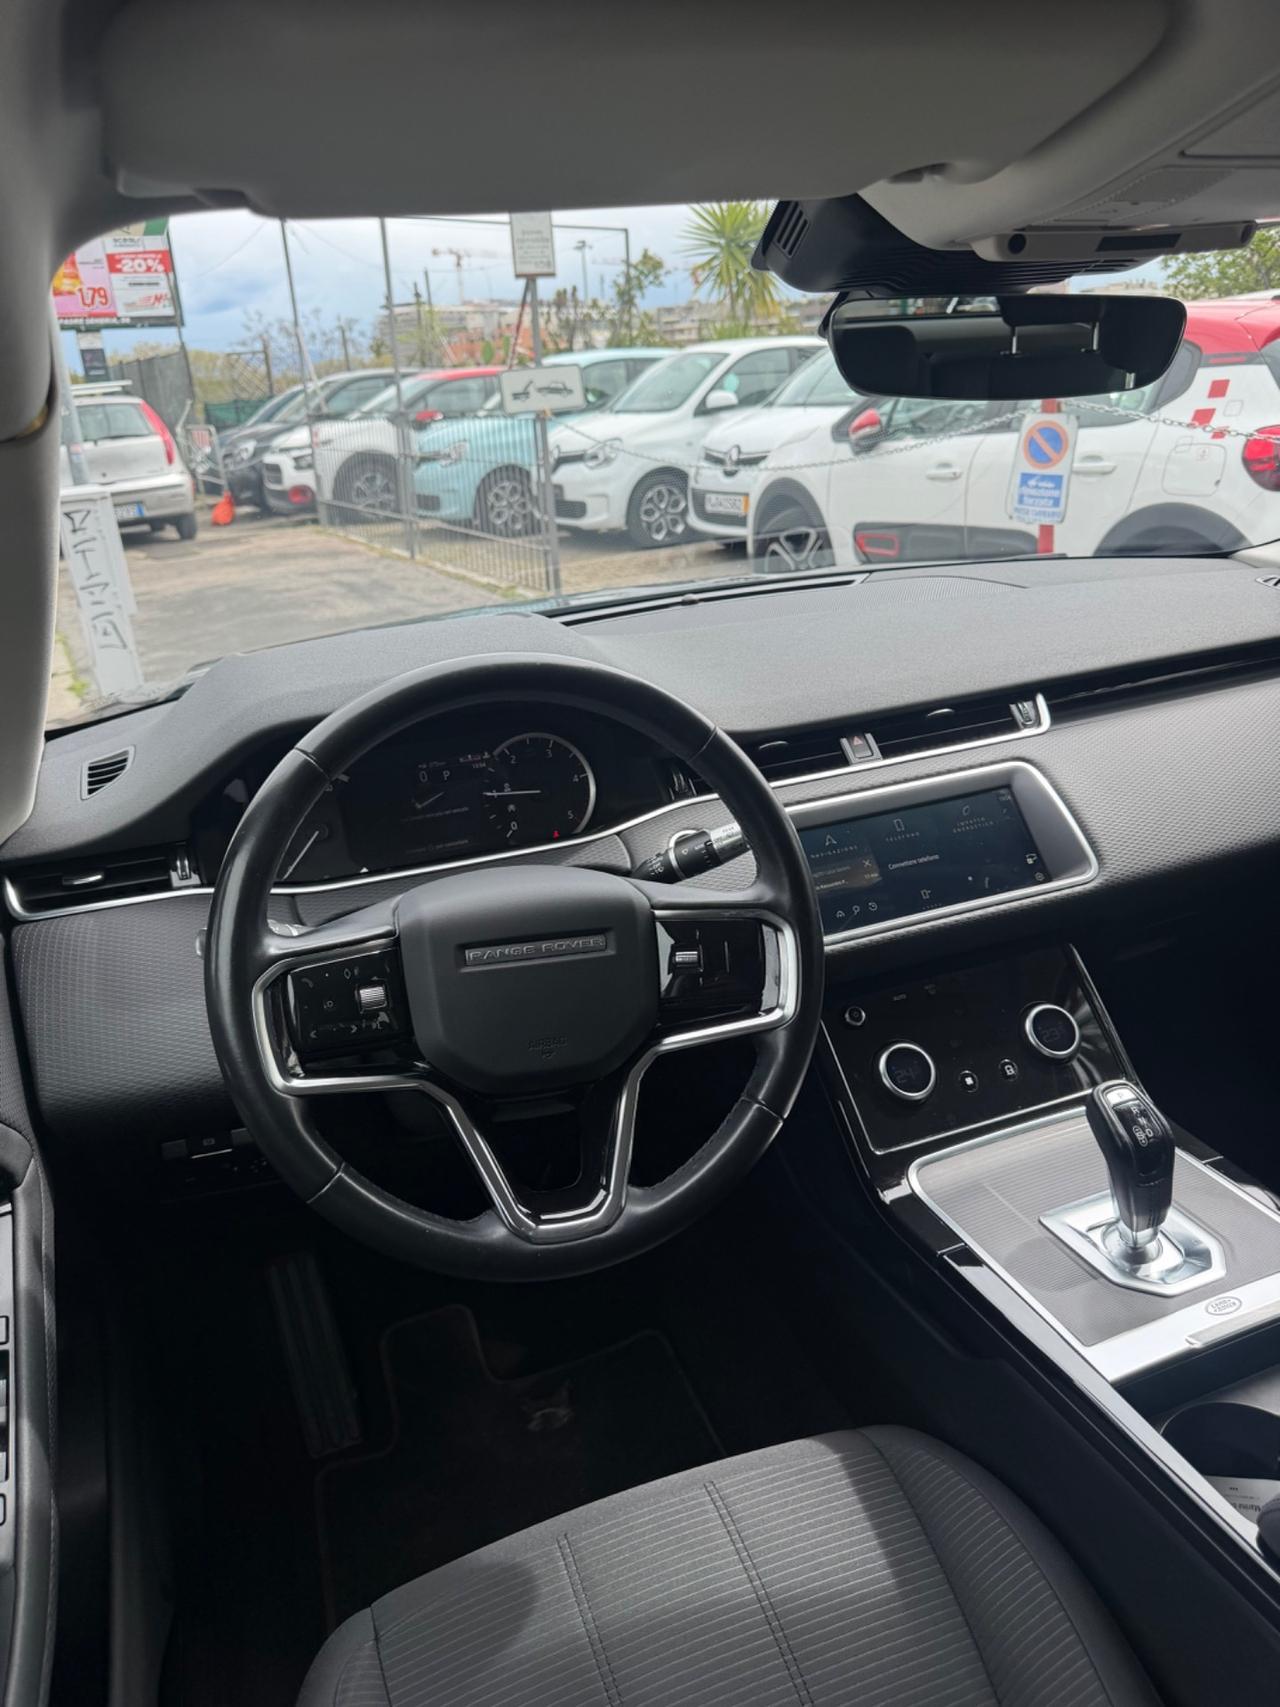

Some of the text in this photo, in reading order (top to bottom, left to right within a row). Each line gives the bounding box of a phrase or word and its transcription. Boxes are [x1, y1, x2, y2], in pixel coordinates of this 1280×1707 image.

[115, 257, 165, 273] -20%
[469, 936, 606, 961] RANGE ROVER
